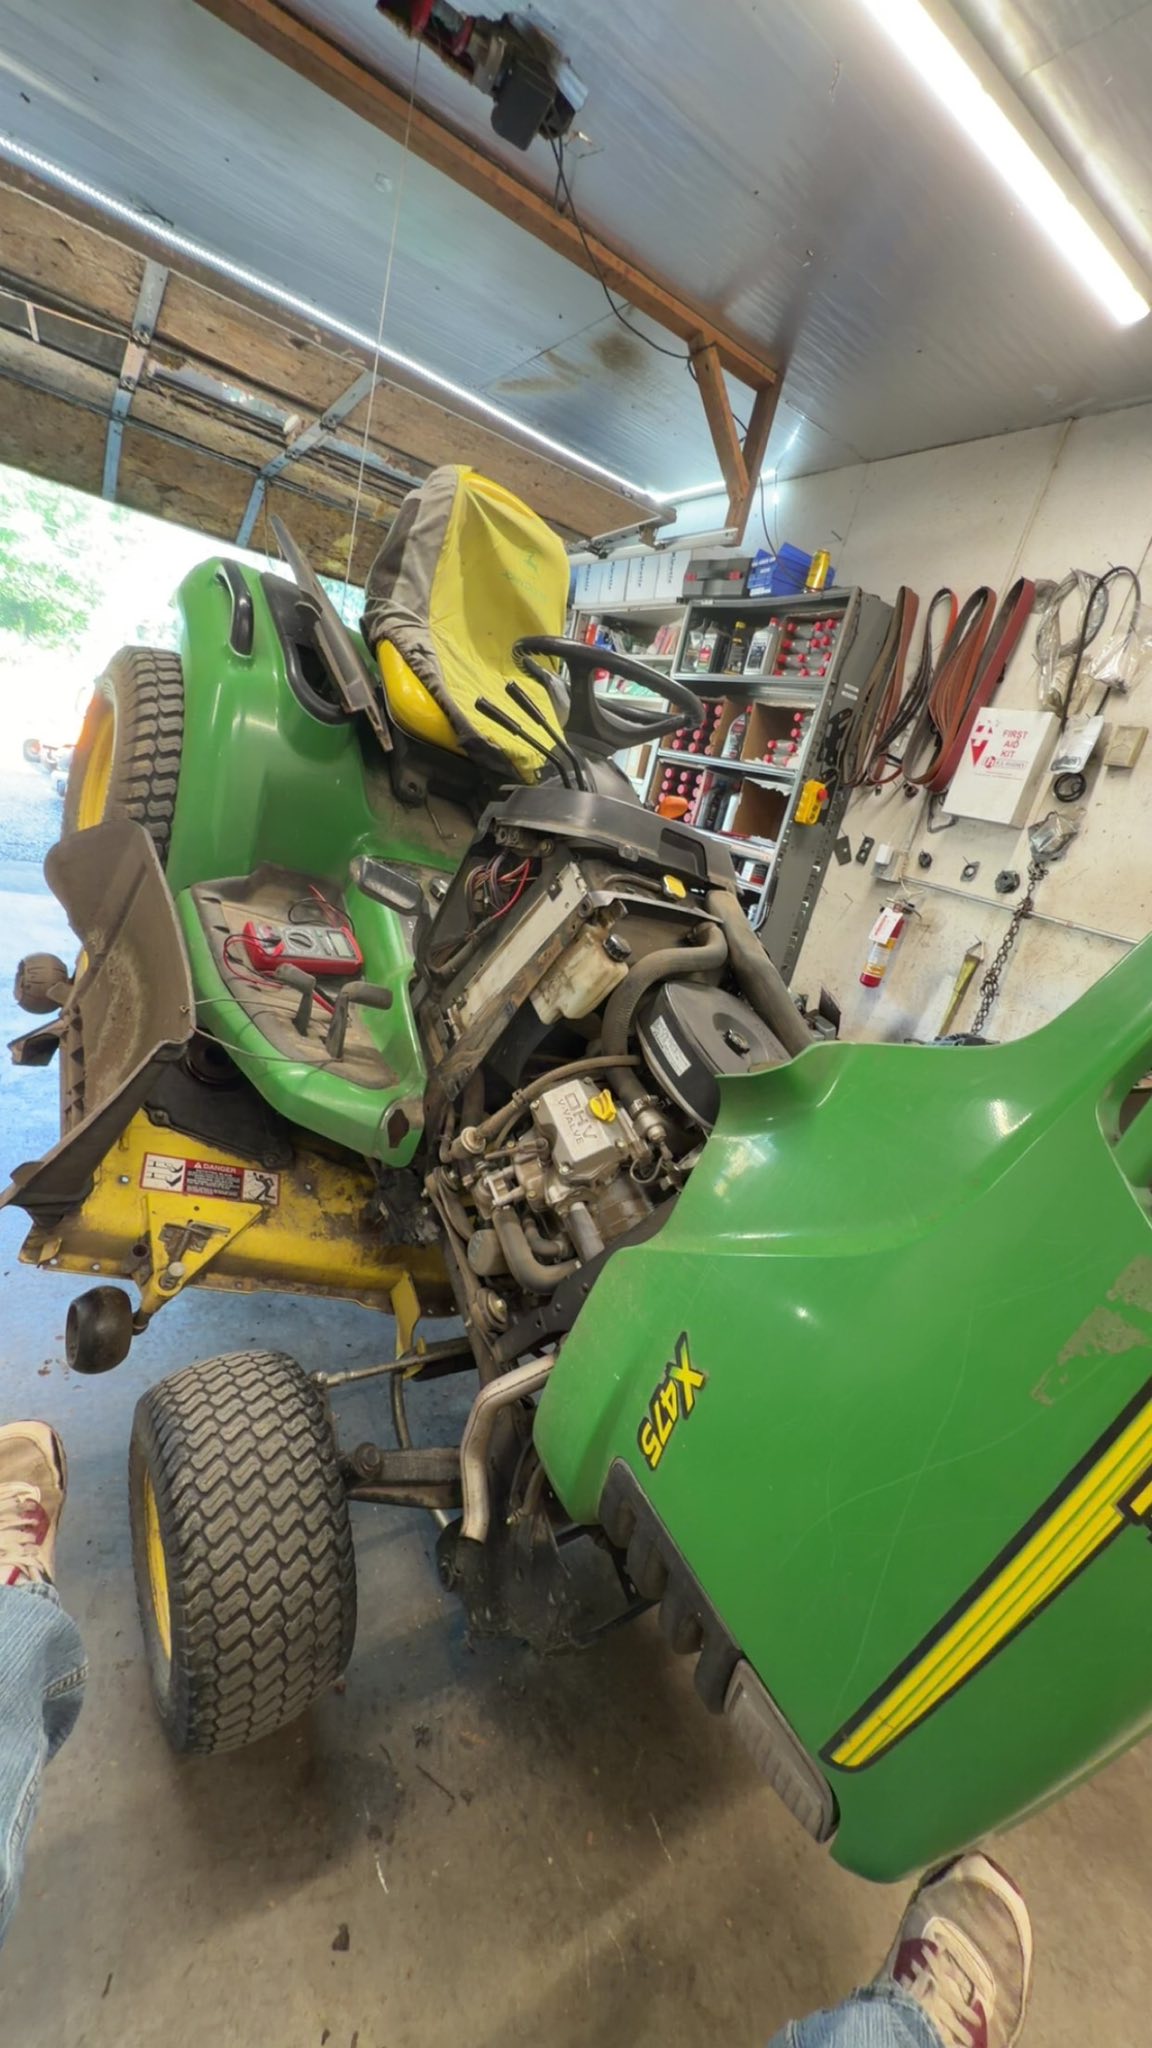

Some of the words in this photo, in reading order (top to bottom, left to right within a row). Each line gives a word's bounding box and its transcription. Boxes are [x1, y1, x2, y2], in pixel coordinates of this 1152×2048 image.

[1003, 730, 1028, 739] FIRST
[1004, 741, 1020, 749] AID
[564, 1092, 598, 1140] OHV
[202, 1163, 237, 1174] DANGER
[637, 1331, 706, 1472] X475
